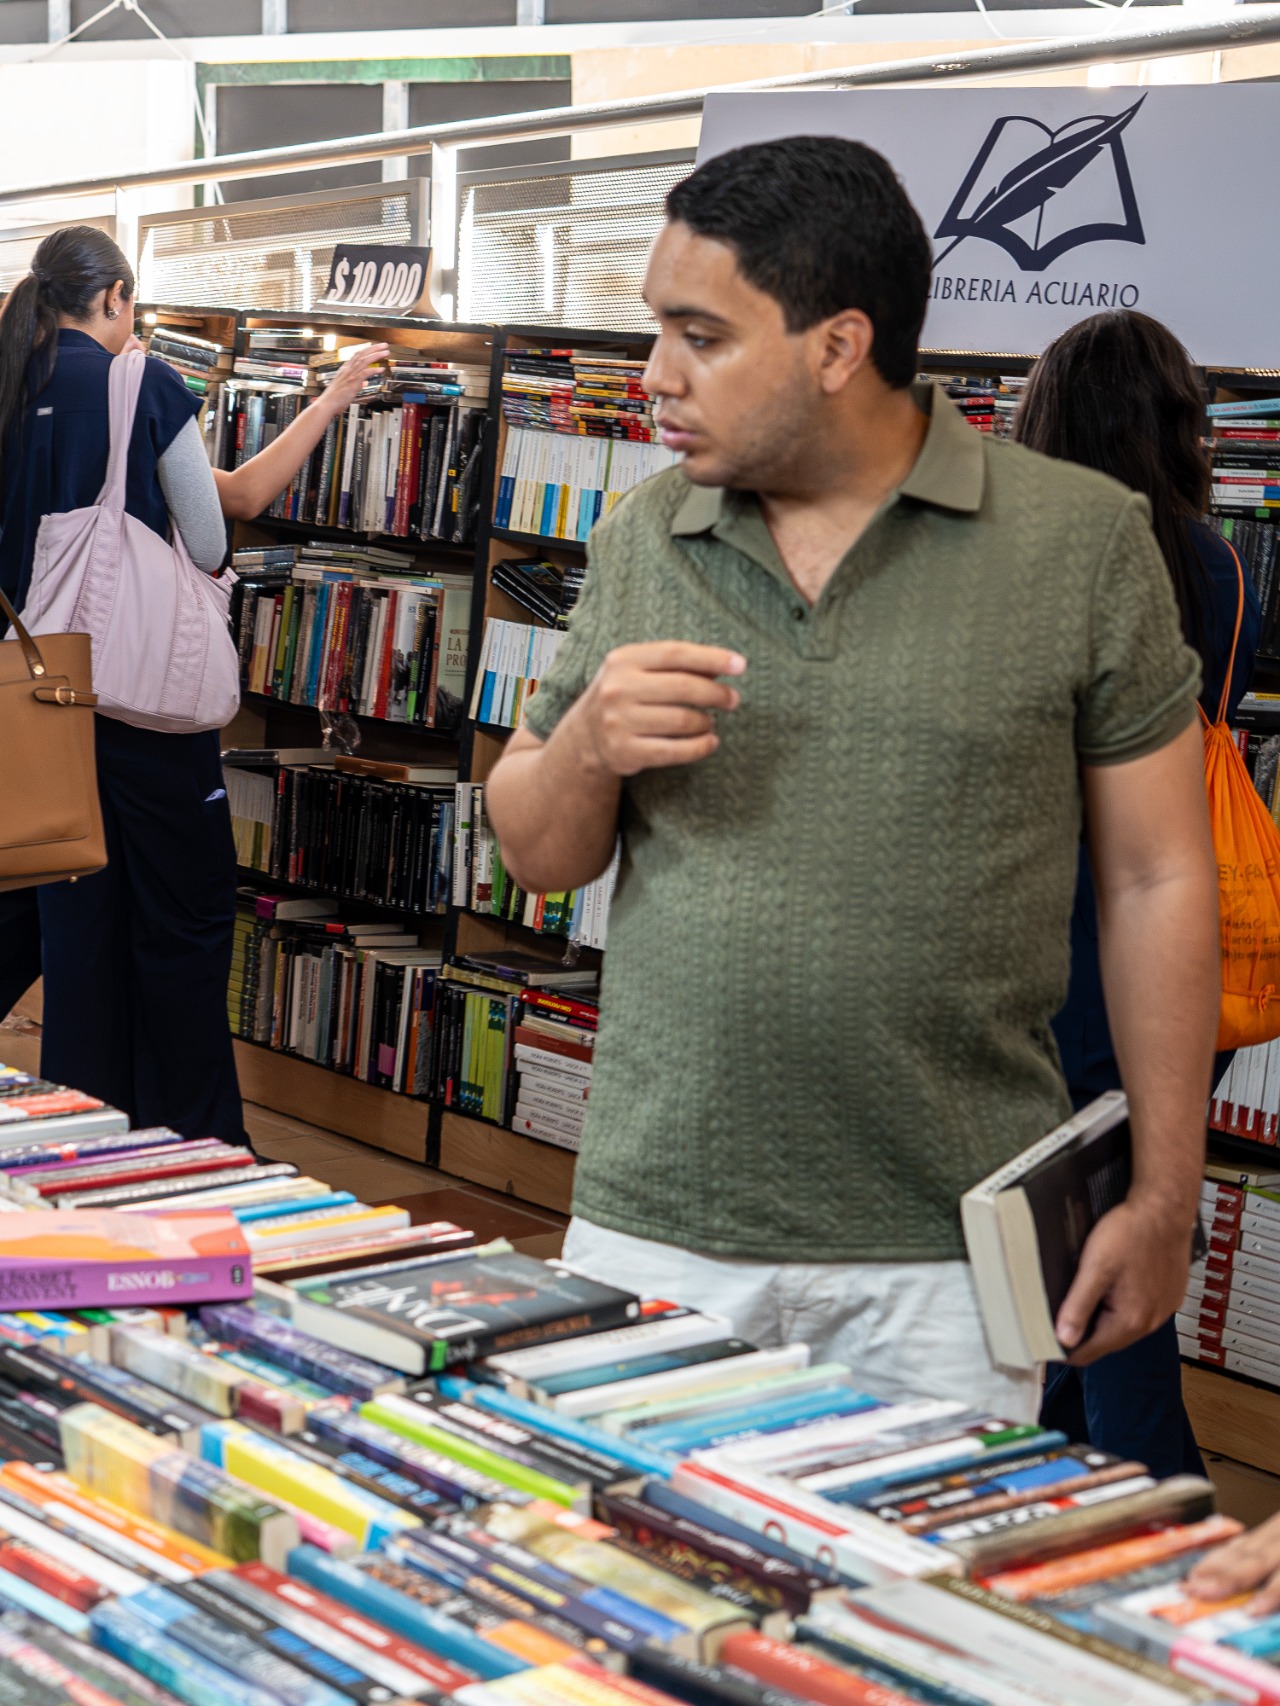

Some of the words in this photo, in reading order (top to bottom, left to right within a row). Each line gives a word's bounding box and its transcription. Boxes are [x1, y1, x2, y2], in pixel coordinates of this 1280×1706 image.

[1025, 280, 1140, 308] ACUARIO
[447, 636, 463, 651] LA
[445, 653, 470, 667] PRO
[107, 1270, 176, 1292] ESNOB
